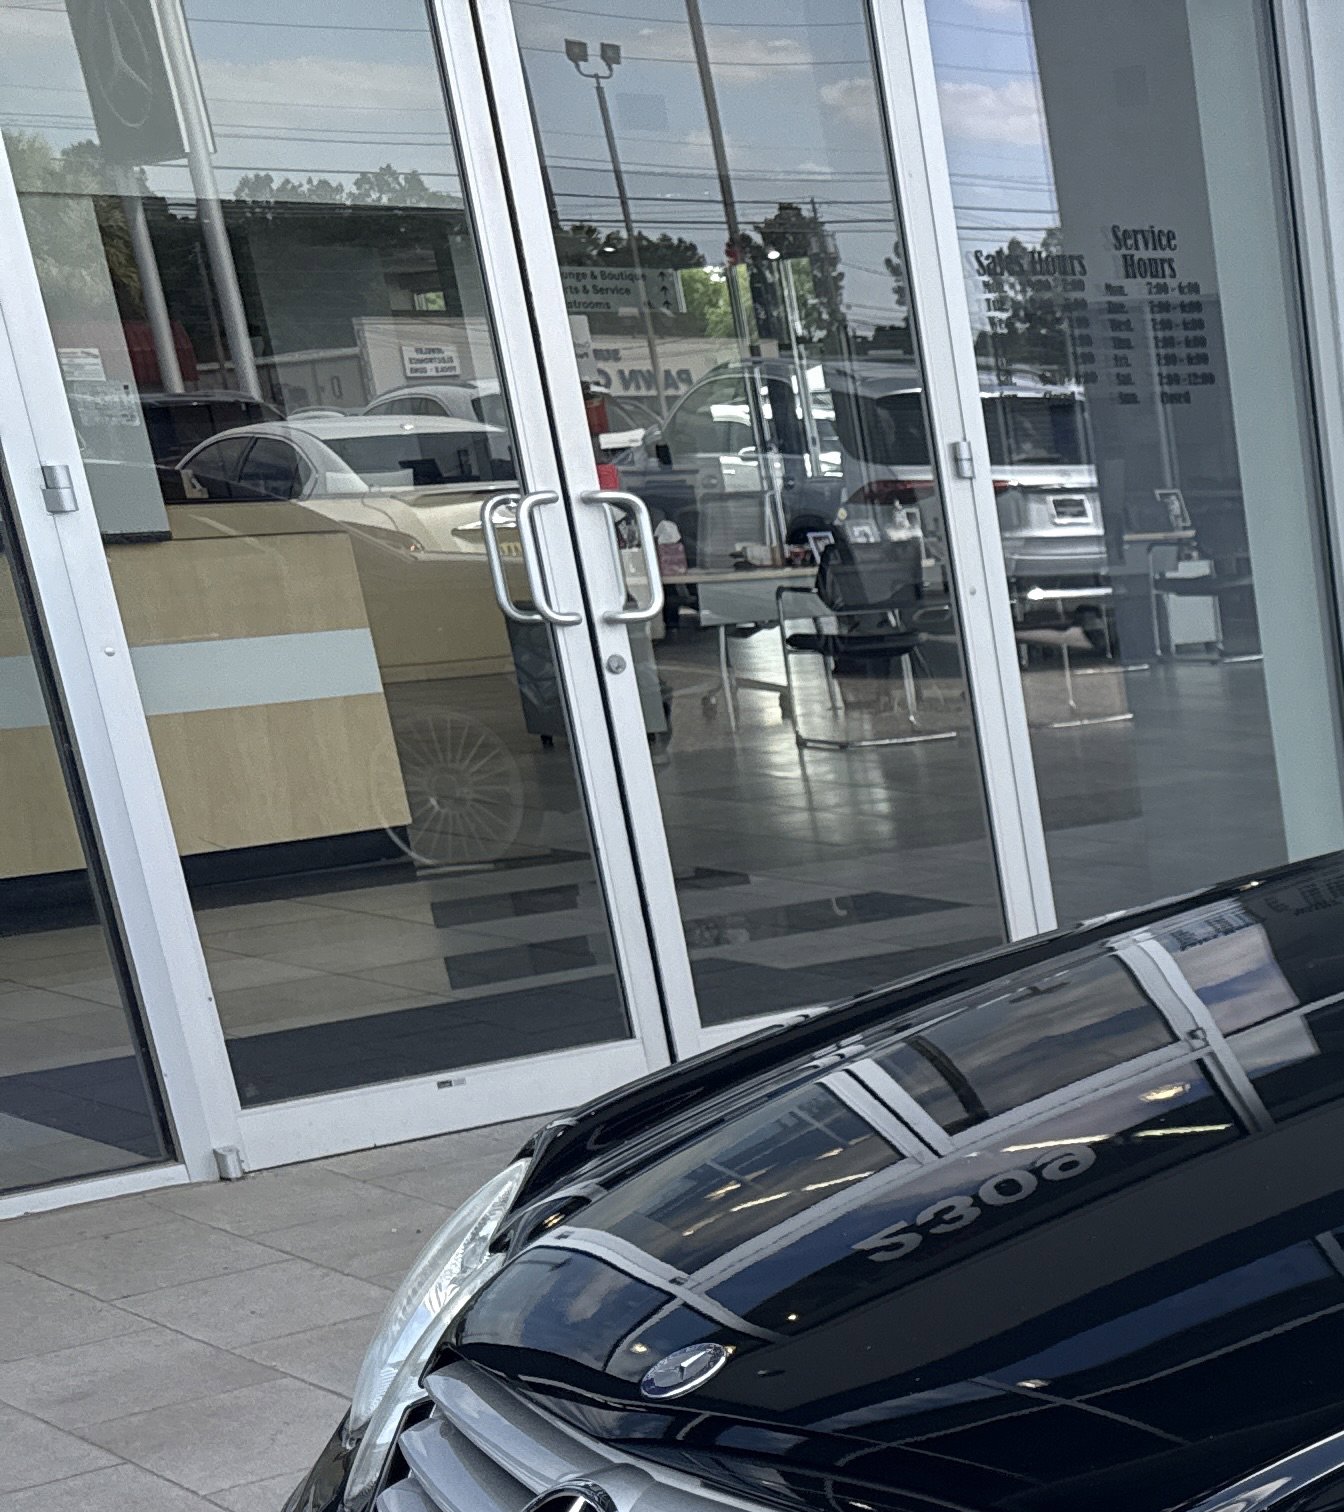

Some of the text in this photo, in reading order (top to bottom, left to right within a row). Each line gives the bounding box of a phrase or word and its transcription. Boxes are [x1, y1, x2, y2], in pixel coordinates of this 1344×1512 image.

[1111, 224, 1177, 251] Service
[1122, 254, 1177, 279] Hours
[561, 271, 588, 282] unge
[600, 270, 647, 283] Boutique
[565, 285, 578, 295] rts
[592, 284, 631, 296] Service
[567, 300, 611, 310] strooms
